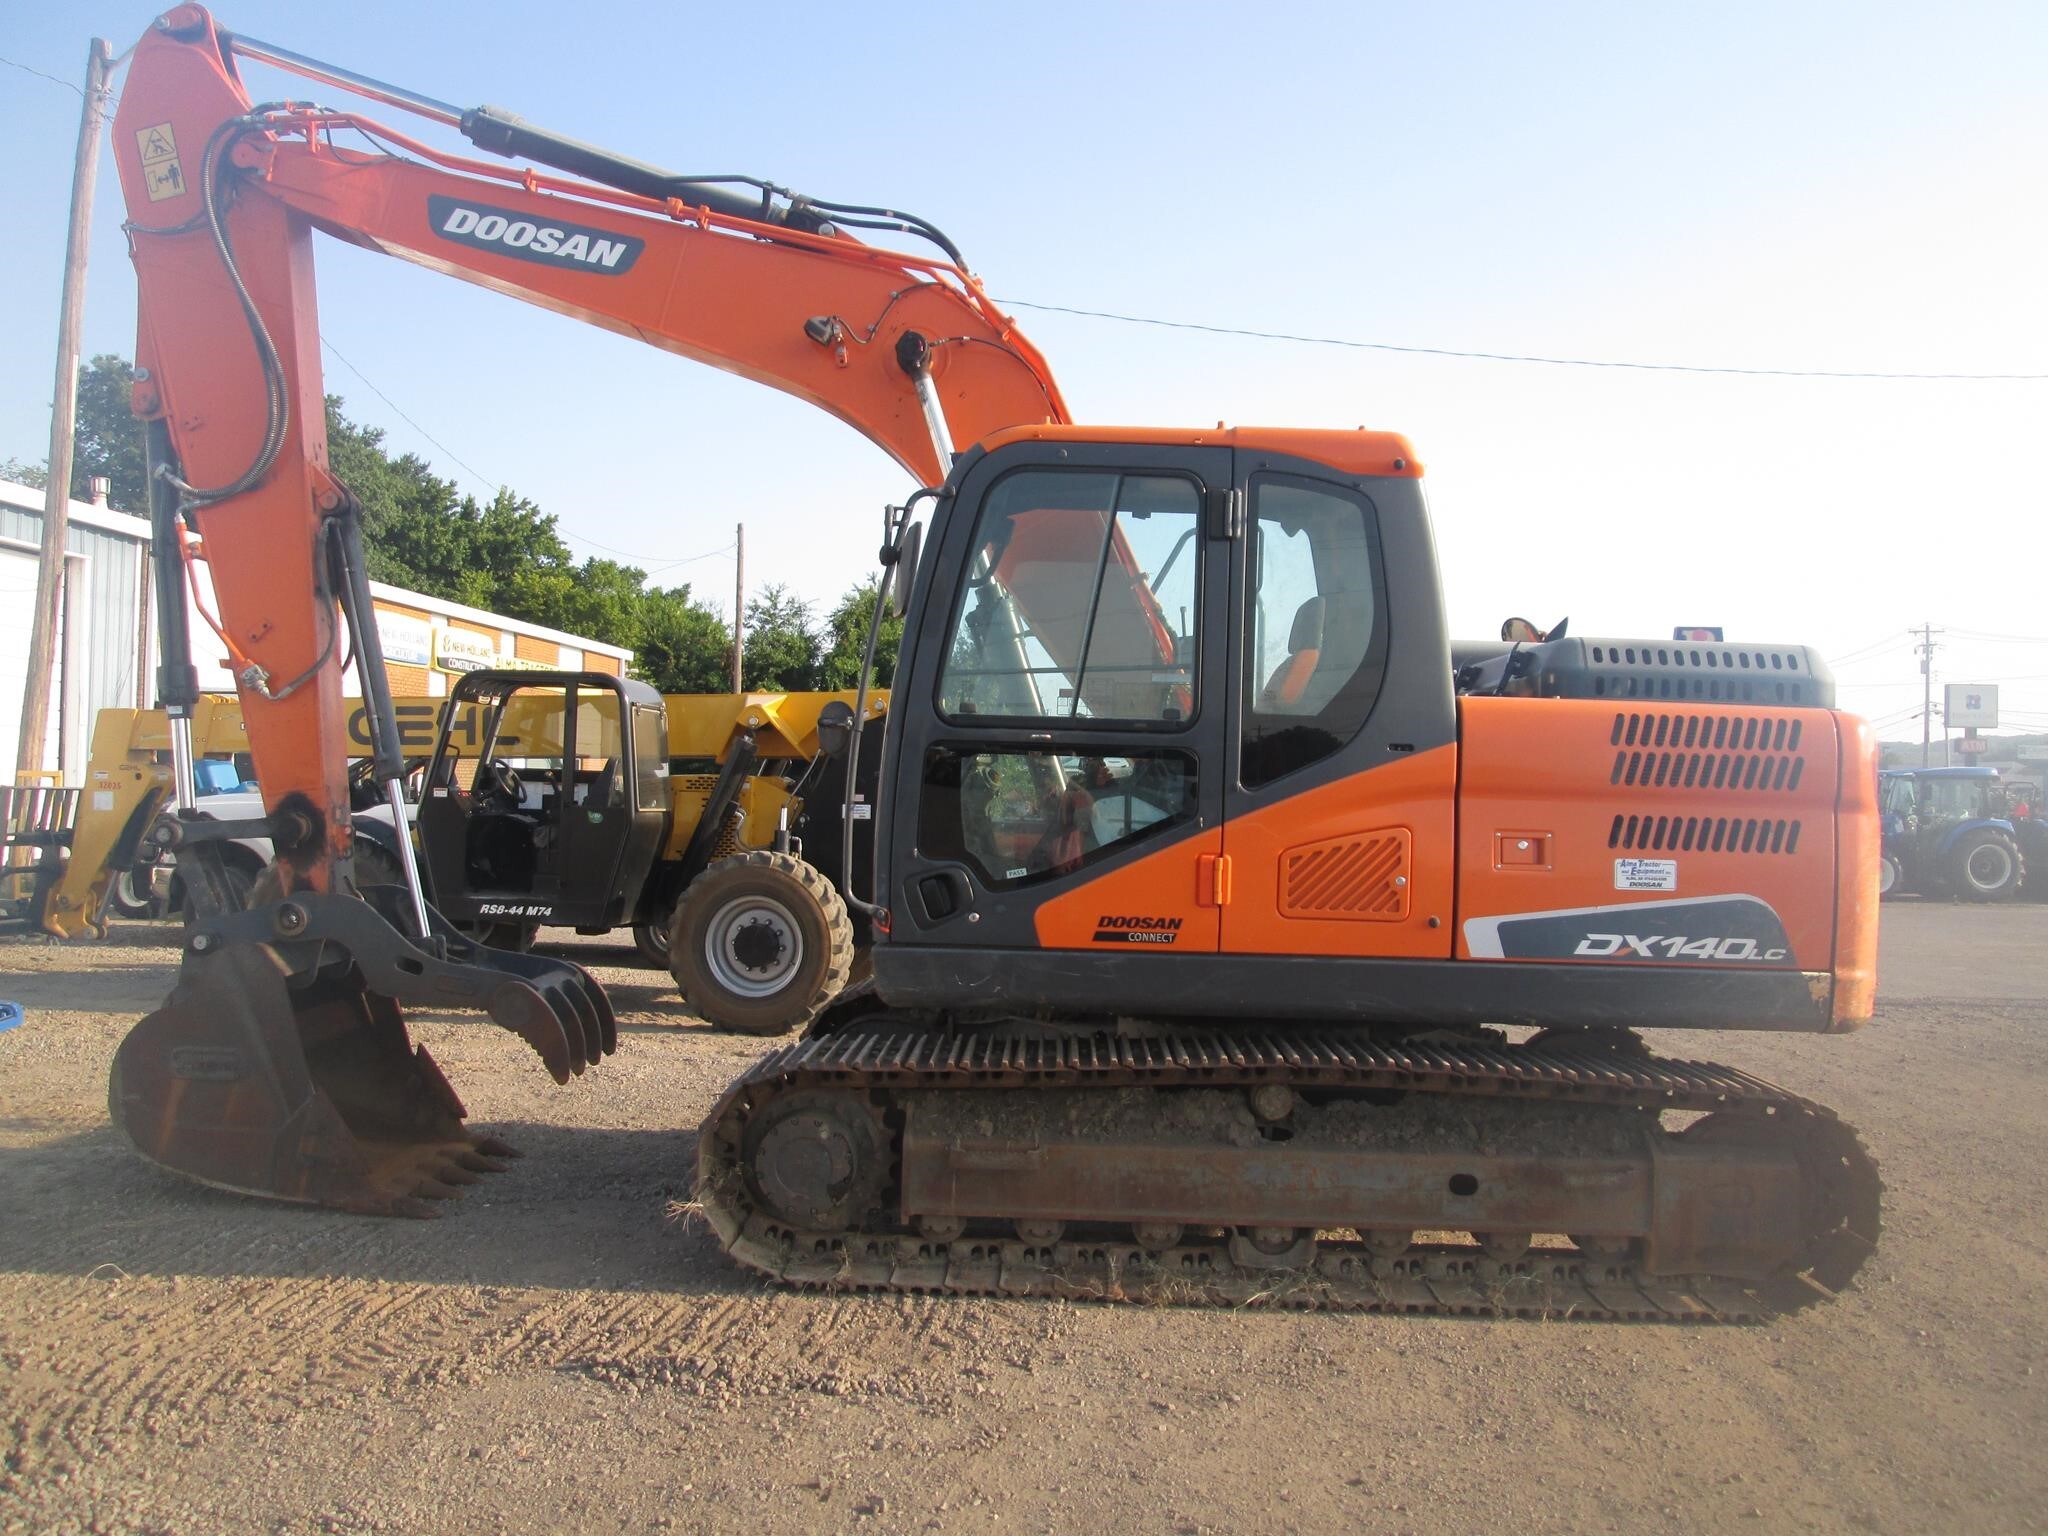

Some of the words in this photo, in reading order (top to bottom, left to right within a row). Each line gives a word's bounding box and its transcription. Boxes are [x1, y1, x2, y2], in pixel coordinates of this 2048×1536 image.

[443, 208, 627, 267] DOOSAN
[452, 641, 465, 653] NEW
[466, 644, 490, 659] HOLLAND
[1961, 741, 1986, 752] ATM
[1638, 859, 1662, 868] Tractor
[1008, 869, 1025, 877] PASS
[1630, 867, 1664, 876] Equipment
[480, 904, 524, 915] RS8-44
[526, 906, 552, 916] M74
[1097, 916, 1184, 930] DOOSAN
[1128, 932, 1175, 943] CONNECT
